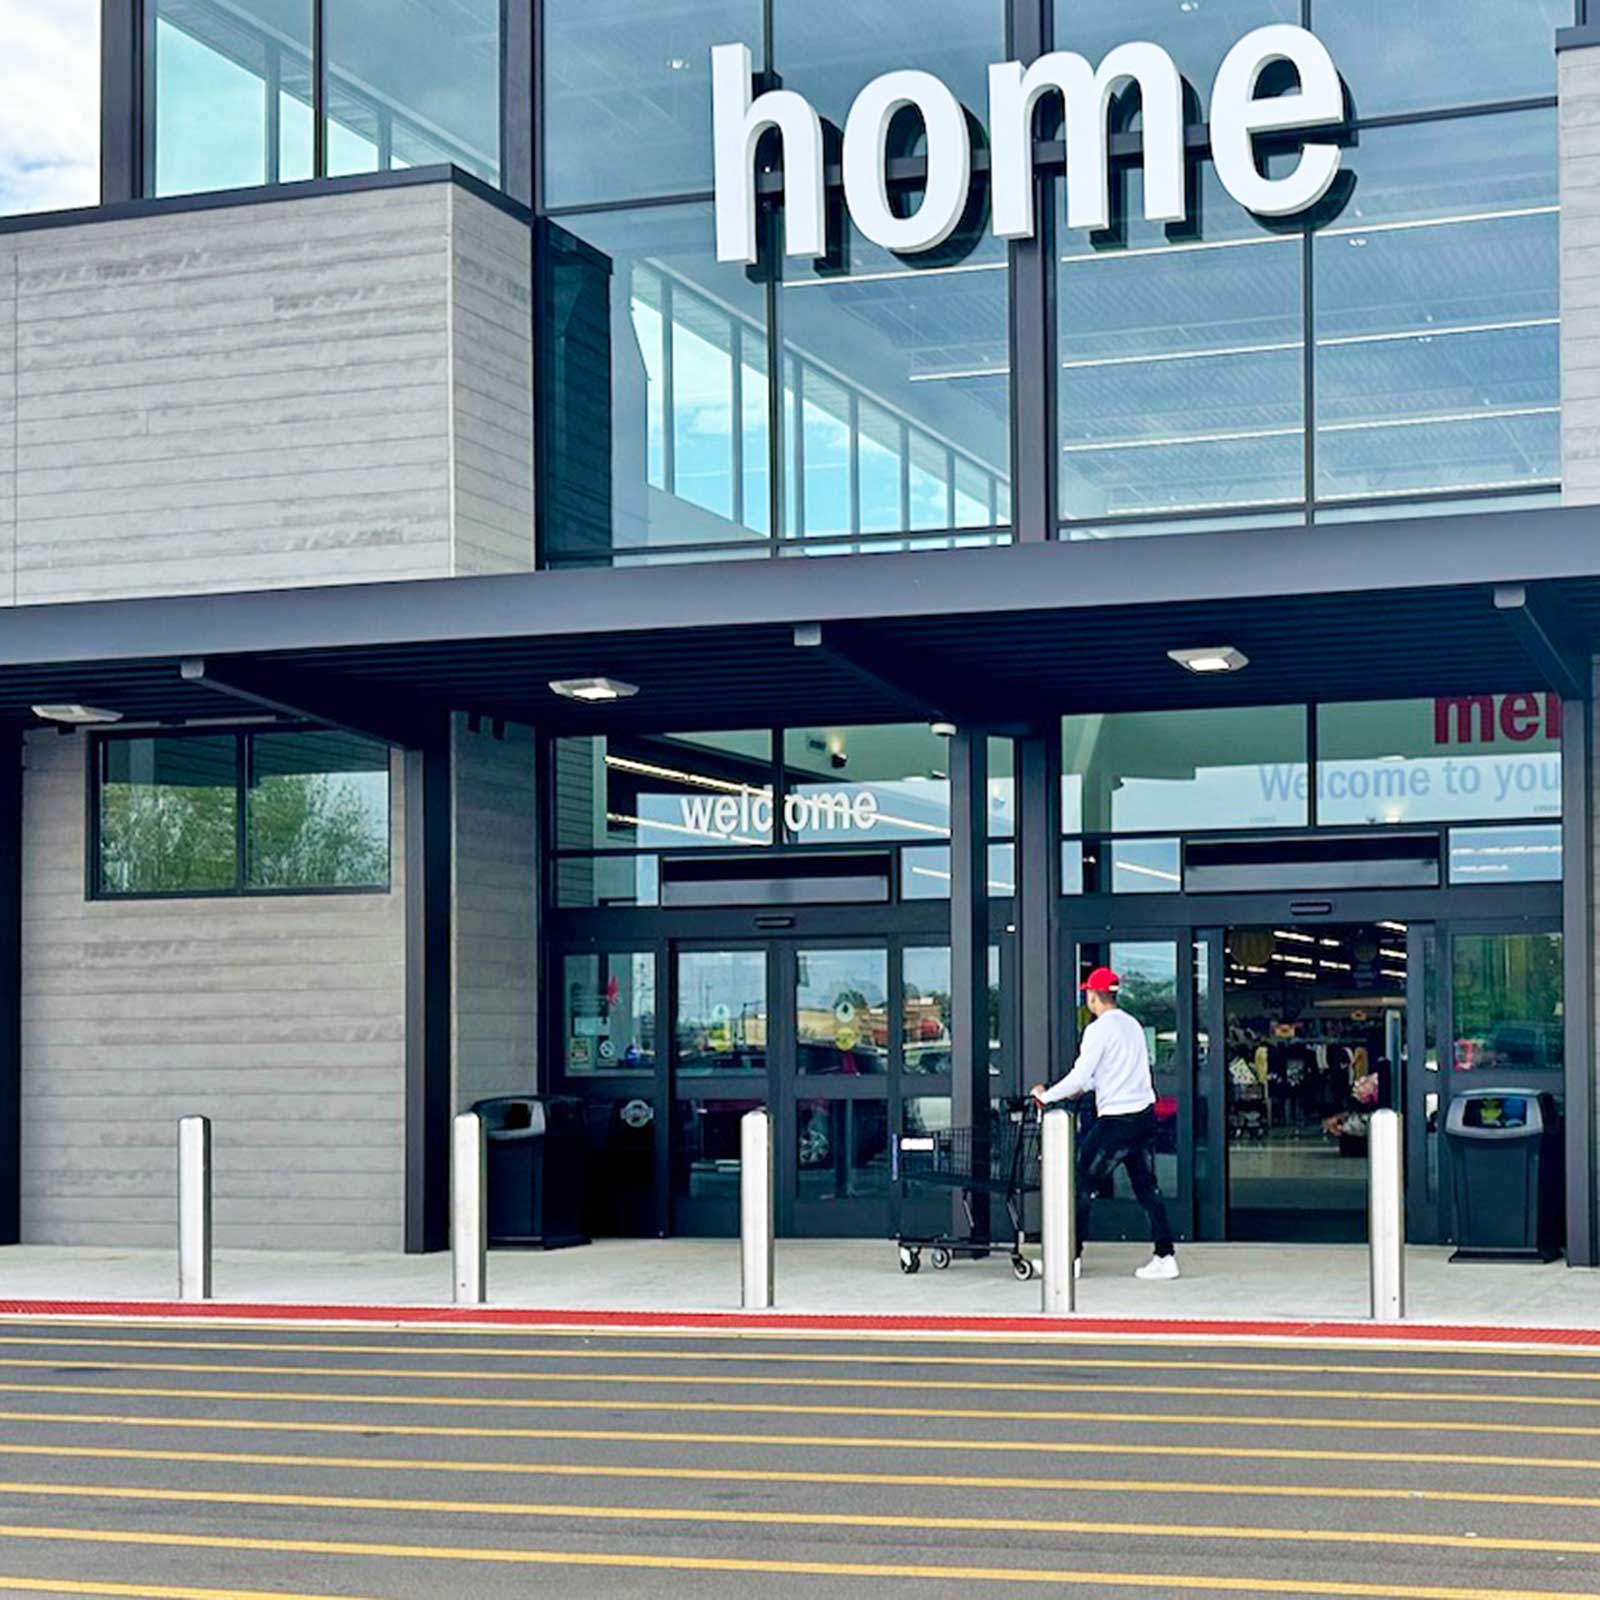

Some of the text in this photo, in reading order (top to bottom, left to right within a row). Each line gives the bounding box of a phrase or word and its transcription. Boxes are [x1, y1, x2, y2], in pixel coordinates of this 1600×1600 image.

[711, 23, 1343, 264] home
[1257, 762, 1431, 802] Welcome
[1442, 760, 1481, 795] to
[679, 783, 878, 835] welcome
